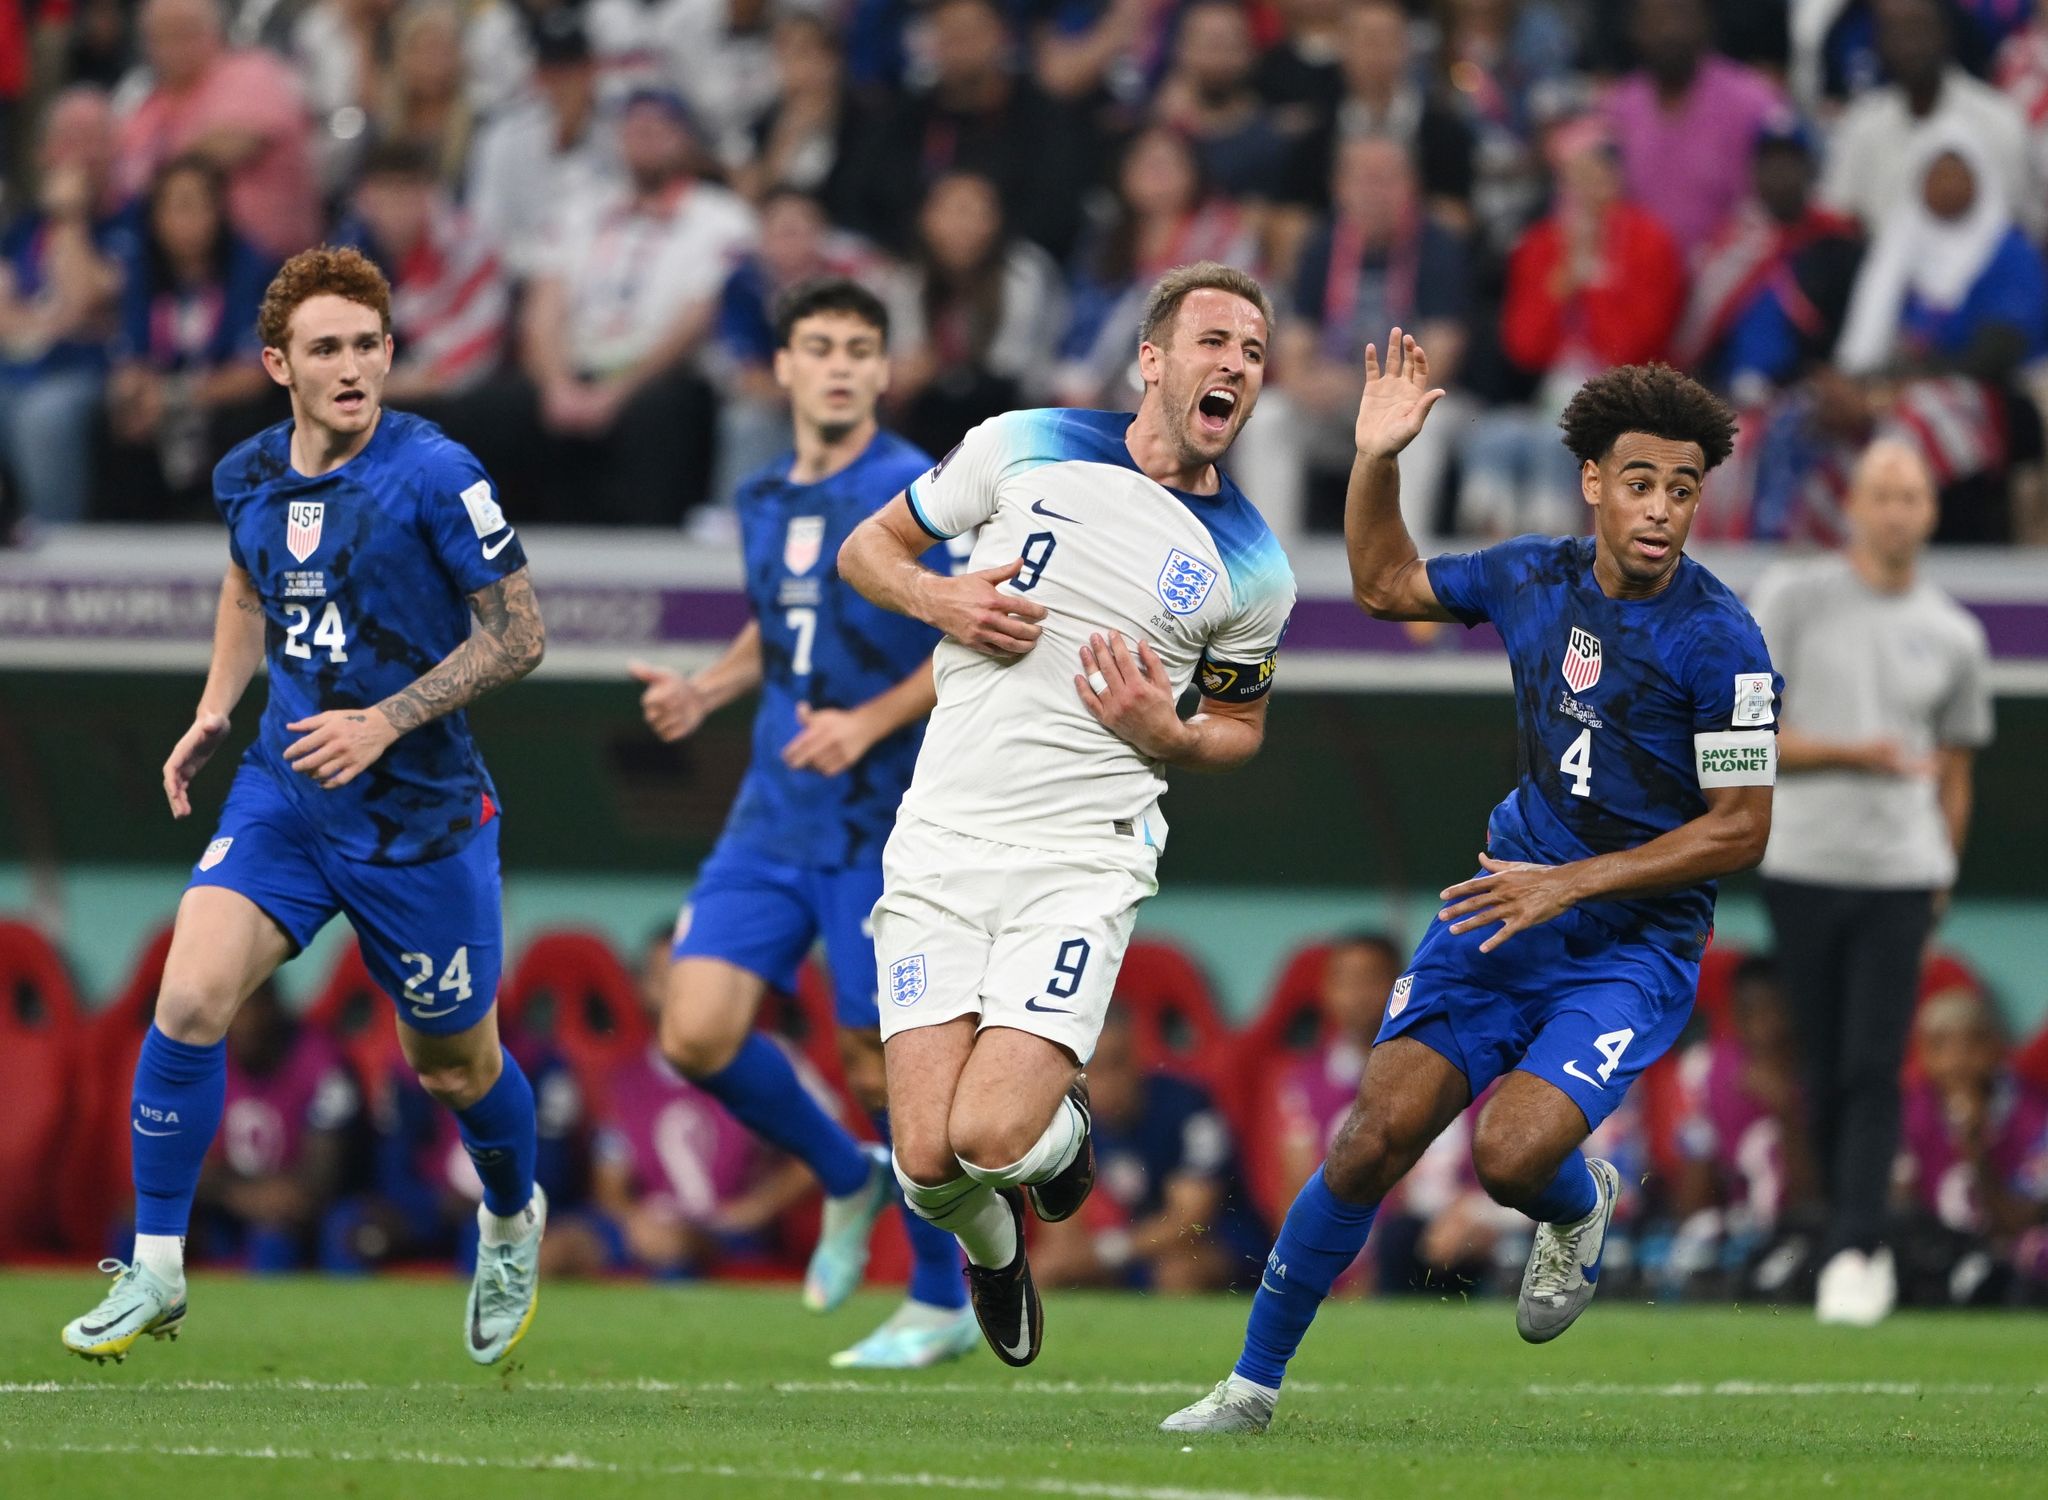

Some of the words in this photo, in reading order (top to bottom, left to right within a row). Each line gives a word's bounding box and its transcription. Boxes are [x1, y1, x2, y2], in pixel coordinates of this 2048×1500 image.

[291, 506, 321, 528] USA
[1009, 531, 1057, 592] 9
[284, 601, 348, 663] 24
[786, 607, 817, 675] 7
[1571, 630, 1600, 659] USA
[1559, 728, 1592, 798] 4
[1702, 748, 1738, 760] SAVE
[1741, 747, 1767, 758] THE
[1702, 759, 1768, 773] PLANET
[400, 945, 473, 1006] 24
[1046, 937, 1091, 998] 9
[1395, 977, 1412, 995] USA
[1593, 1027, 1635, 1083] 4
[140, 1103, 180, 1123] USA
[1268, 1246, 1287, 1280] USA
